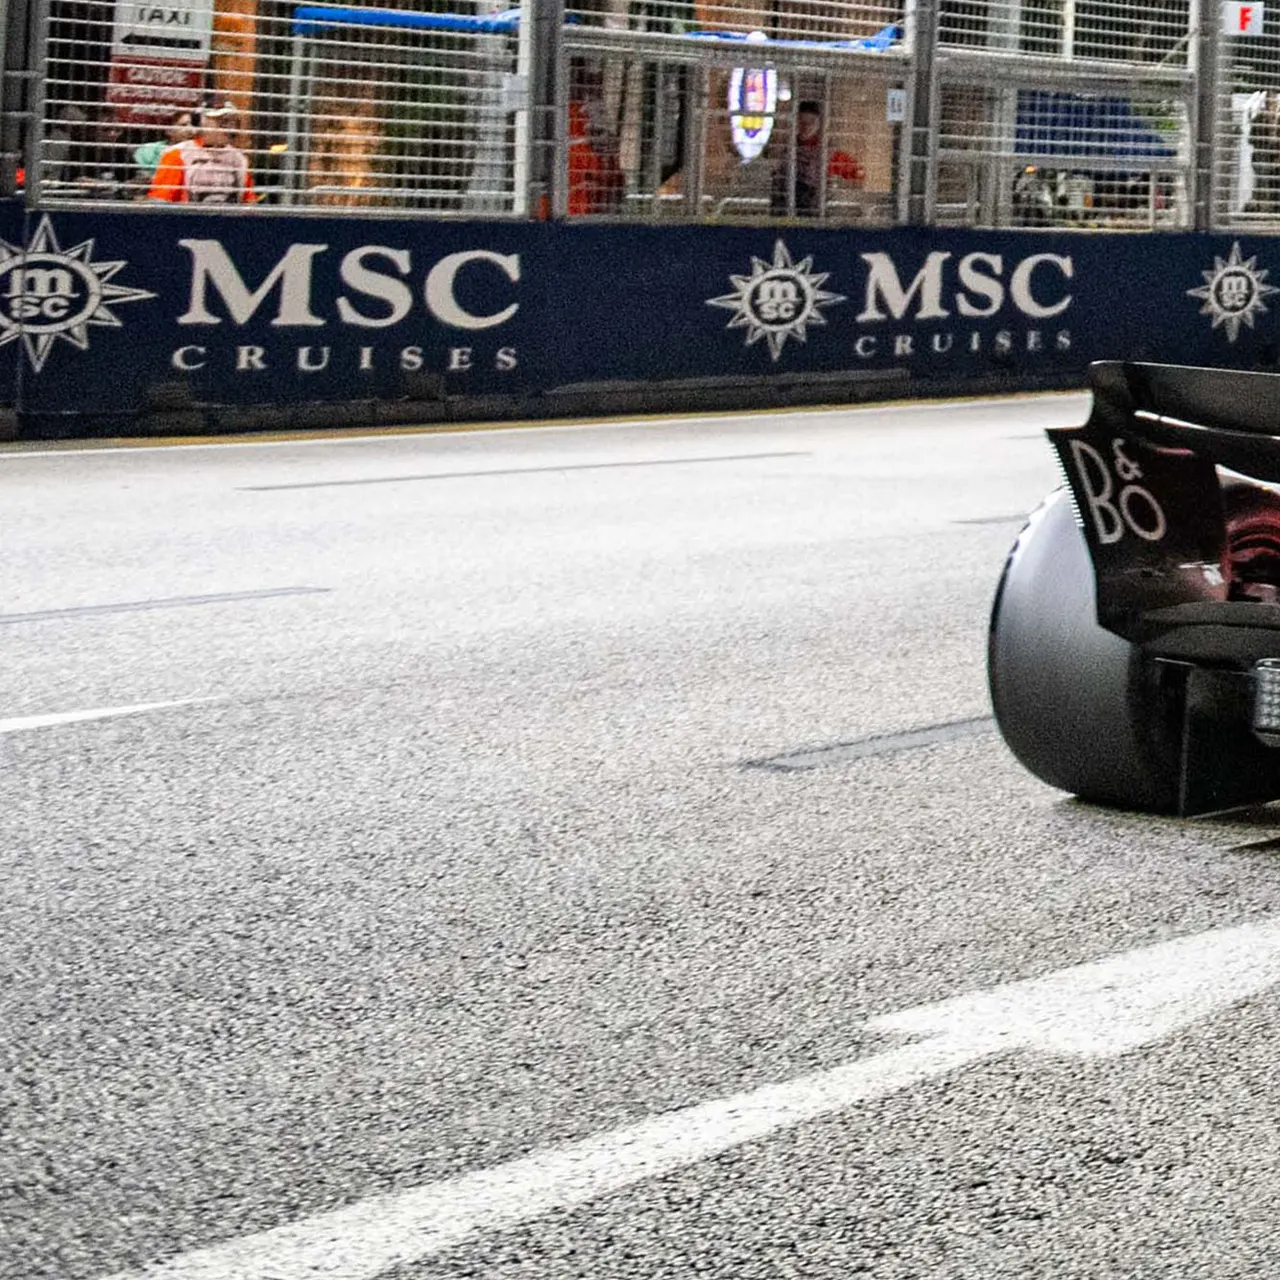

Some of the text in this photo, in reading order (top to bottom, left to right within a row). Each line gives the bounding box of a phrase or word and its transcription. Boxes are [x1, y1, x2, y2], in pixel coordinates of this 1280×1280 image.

[138, 3, 191, 25] TAXI
[1239, 6, 1254, 32] F
[177, 238, 521, 329] MSC
[855, 251, 1074, 321] MSC
[854, 330, 1072, 357] CRUISES
[171, 346, 518, 370] CRUISES
